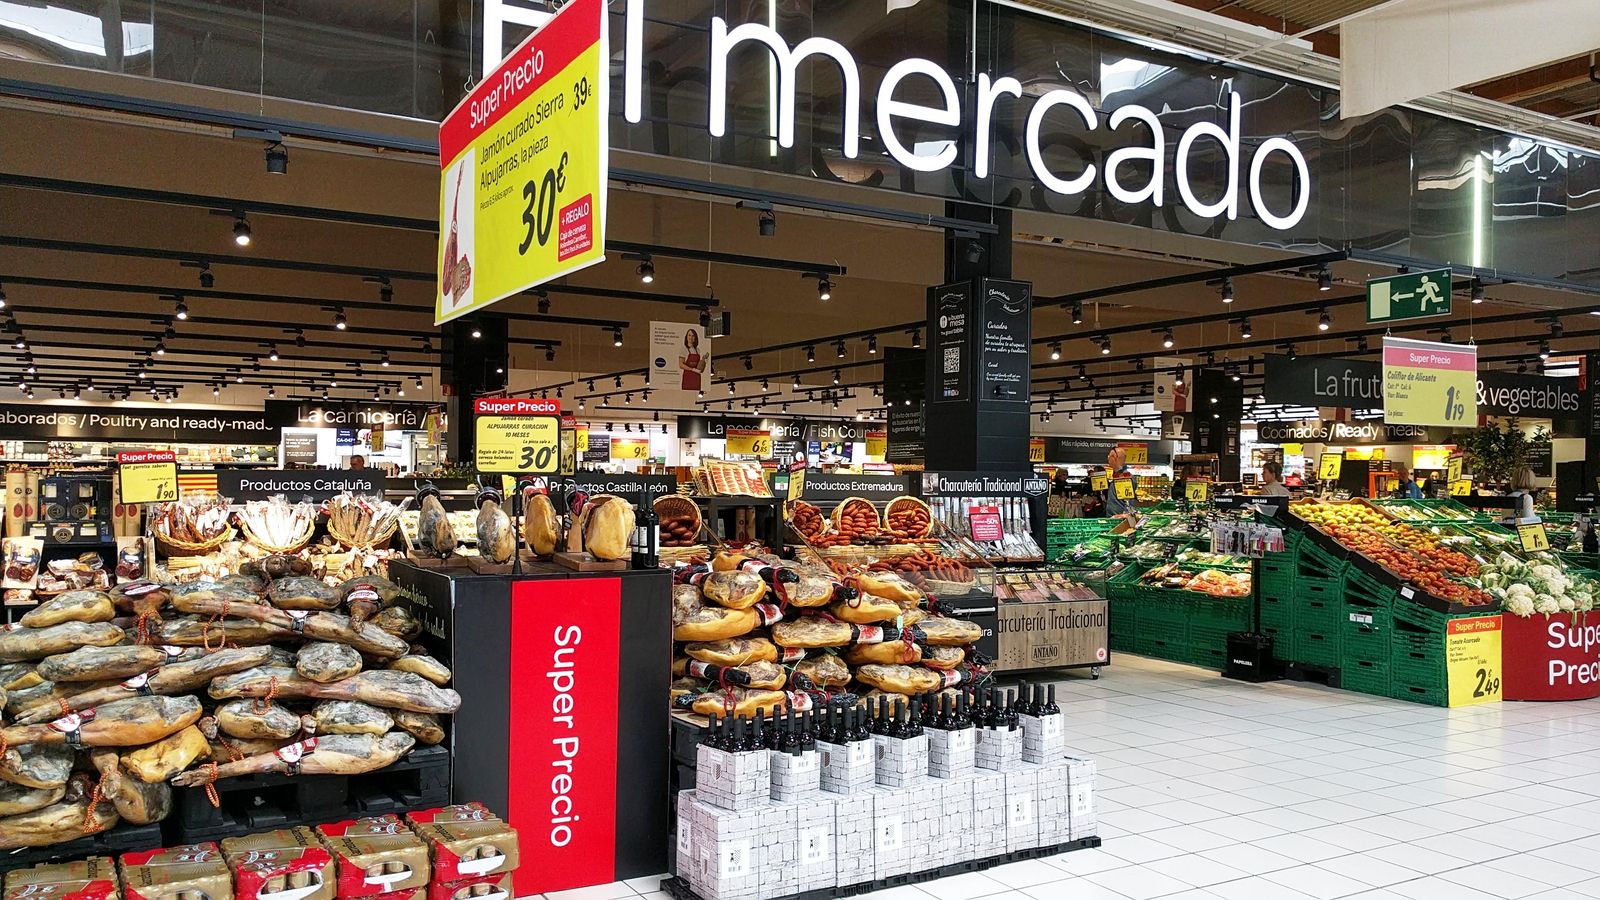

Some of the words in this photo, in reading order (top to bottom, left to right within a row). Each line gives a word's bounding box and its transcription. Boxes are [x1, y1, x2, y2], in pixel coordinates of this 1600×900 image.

[470, 80, 503, 130] Super
[503, 45, 544, 103] Precio
[481, 133, 506, 166] Jamón
[507, 110, 535, 150] curado
[536, 91, 564, 127] Sierra
[710, 16, 1310, 230] mercado
[529, 133, 549, 164] pieza
[565, 202, 590, 225] REGALO
[1410, 353, 1429, 364] Super
[1430, 355, 1451, 365] Precio
[1314, 368, 1338, 397] La
[1415, 373, 1437, 382] Alicante
[479, 401, 516, 414] Super
[518, 400, 556, 412] Precio
[1490, 385, 1579, 414] vegetables
[90, 414, 148, 431] Poultry
[150, 414, 180, 429] and
[298, 406, 321, 423] La
[323, 408, 417, 426] carnicería
[708, 421, 724, 435] La
[810, 425, 836, 437] Fish
[1260, 425, 1328, 440] Cocinados
[1336, 421, 1379, 441] Ready
[1381, 424, 1426, 438] meals
[121, 454, 146, 463] Super
[147, 452, 174, 461] Precio
[240, 479, 311, 492] Productos
[312, 477, 372, 492] Cataluña
[806, 480, 850, 493] Productos
[851, 481, 904, 494] Extremadura
[939, 477, 982, 492] Charcutería
[983, 477, 1022, 492] Tradicional
[1026, 479, 1047, 491] ANTAÑO
[1048, 606, 1106, 631] Tradicional
[1455, 622, 1475, 633] Super
[1475, 620, 1496, 630] Precio
[1033, 644, 1058, 659] ANTAÑO
[546, 624, 582, 730] Super
[550, 736, 581, 848] Precio
